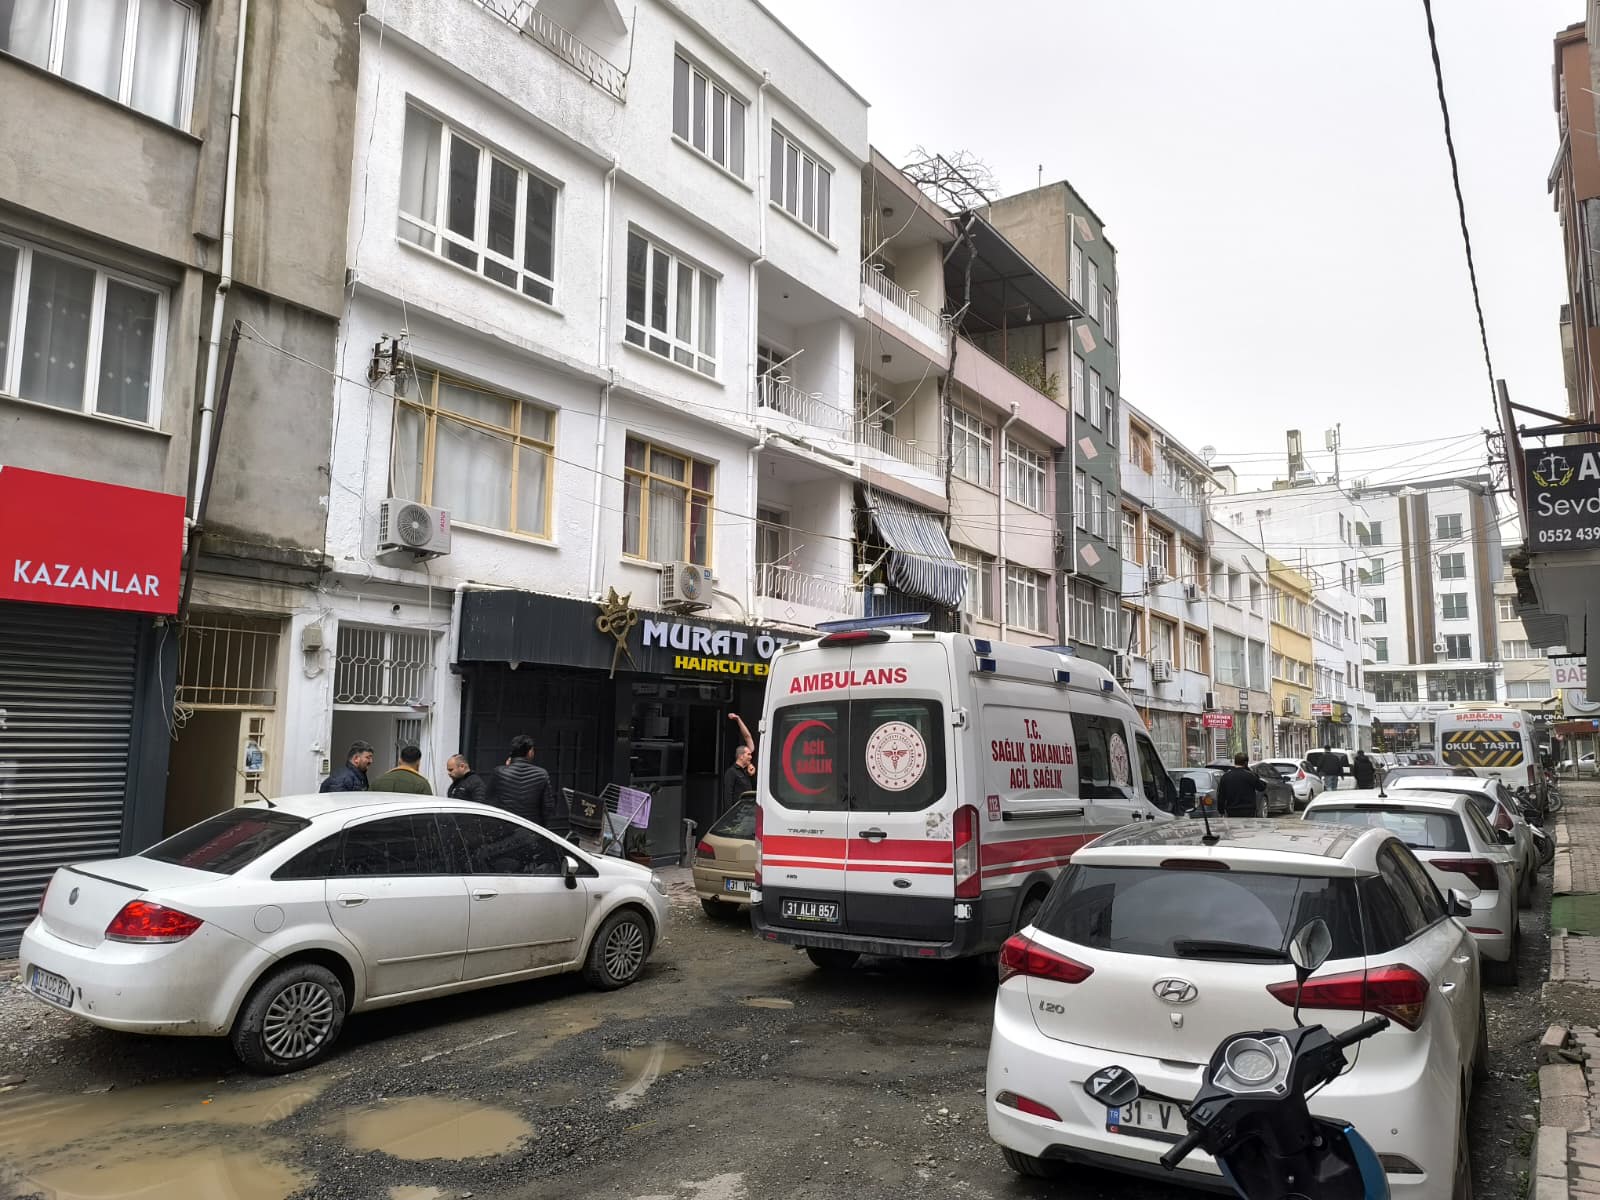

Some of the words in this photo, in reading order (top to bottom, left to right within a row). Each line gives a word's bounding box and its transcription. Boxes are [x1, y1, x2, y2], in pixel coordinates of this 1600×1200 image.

[1577, 452, 1600, 481] A
[1539, 530, 1572, 543] 0552
[1576, 528, 1600, 541] 439
[13, 560, 160, 597] KAZANLAR
[643, 619, 748, 656] MURAT
[790, 668, 908, 694] AMBULANS
[1024, 719, 1041, 740] T.C.
[991, 739, 1026, 762] SAĞLIK
[1030, 741, 1074, 765] BAKANLIĞI
[1445, 742, 1476, 751] OKUL
[1484, 741, 1520, 751] TAŞITI
[1009, 765, 1030, 789] ACİL
[1033, 765, 1063, 788] SAĞLIK
[730, 880, 739, 891] 31
[787, 902, 798, 915] 31
[800, 903, 816, 917] ALH
[818, 905, 835, 918] 857
[1109, 1110, 1119, 1119] TR
[1121, 1101, 1142, 1126] 31
